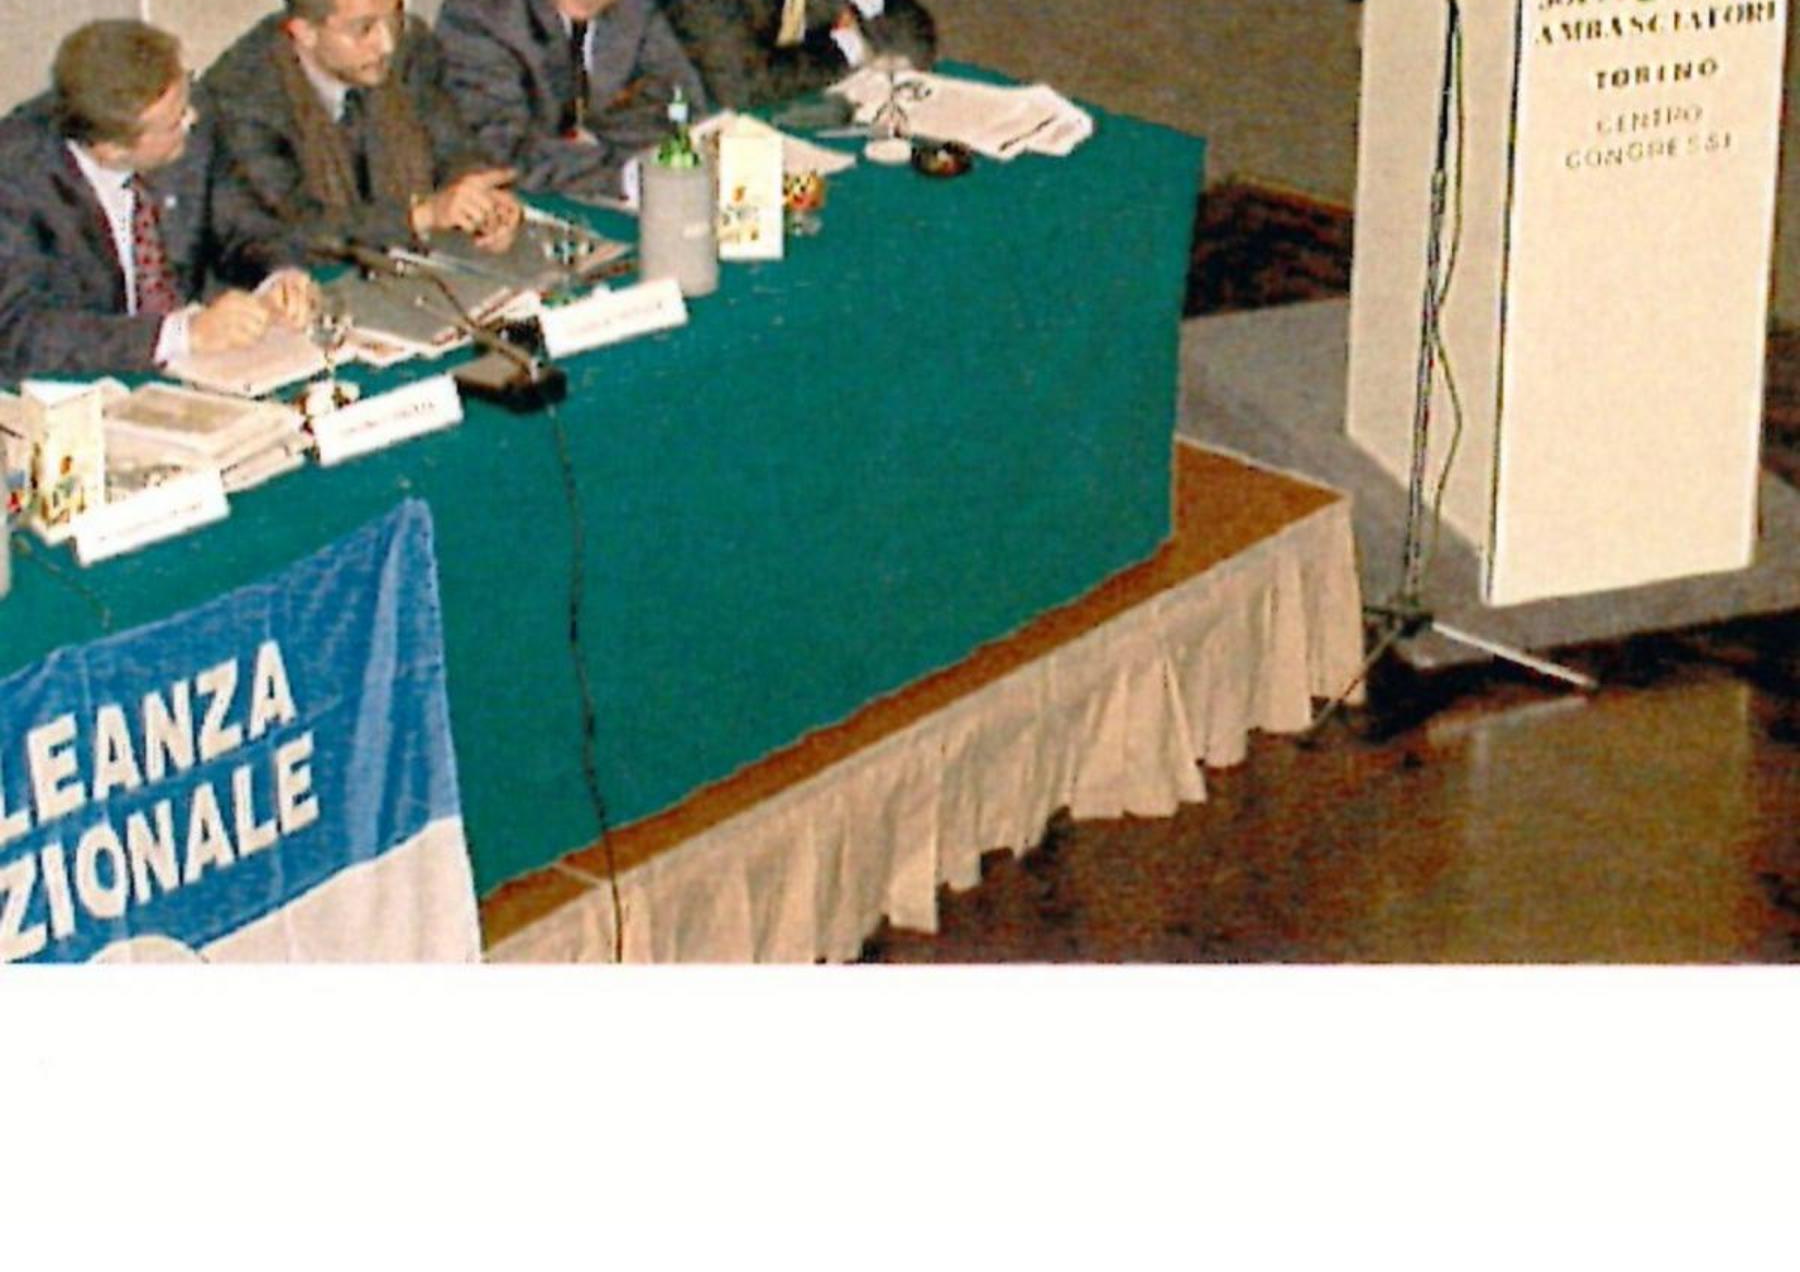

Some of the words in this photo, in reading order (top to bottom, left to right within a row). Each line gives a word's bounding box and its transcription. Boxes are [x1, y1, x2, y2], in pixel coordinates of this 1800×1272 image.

[1534, 0, 1776, 45] AMBASCIATORI
[1595, 57, 1720, 90] TORINO
[1596, 103, 1703, 133] CENTRO
[1564, 131, 1732, 170] CONGRESSI
